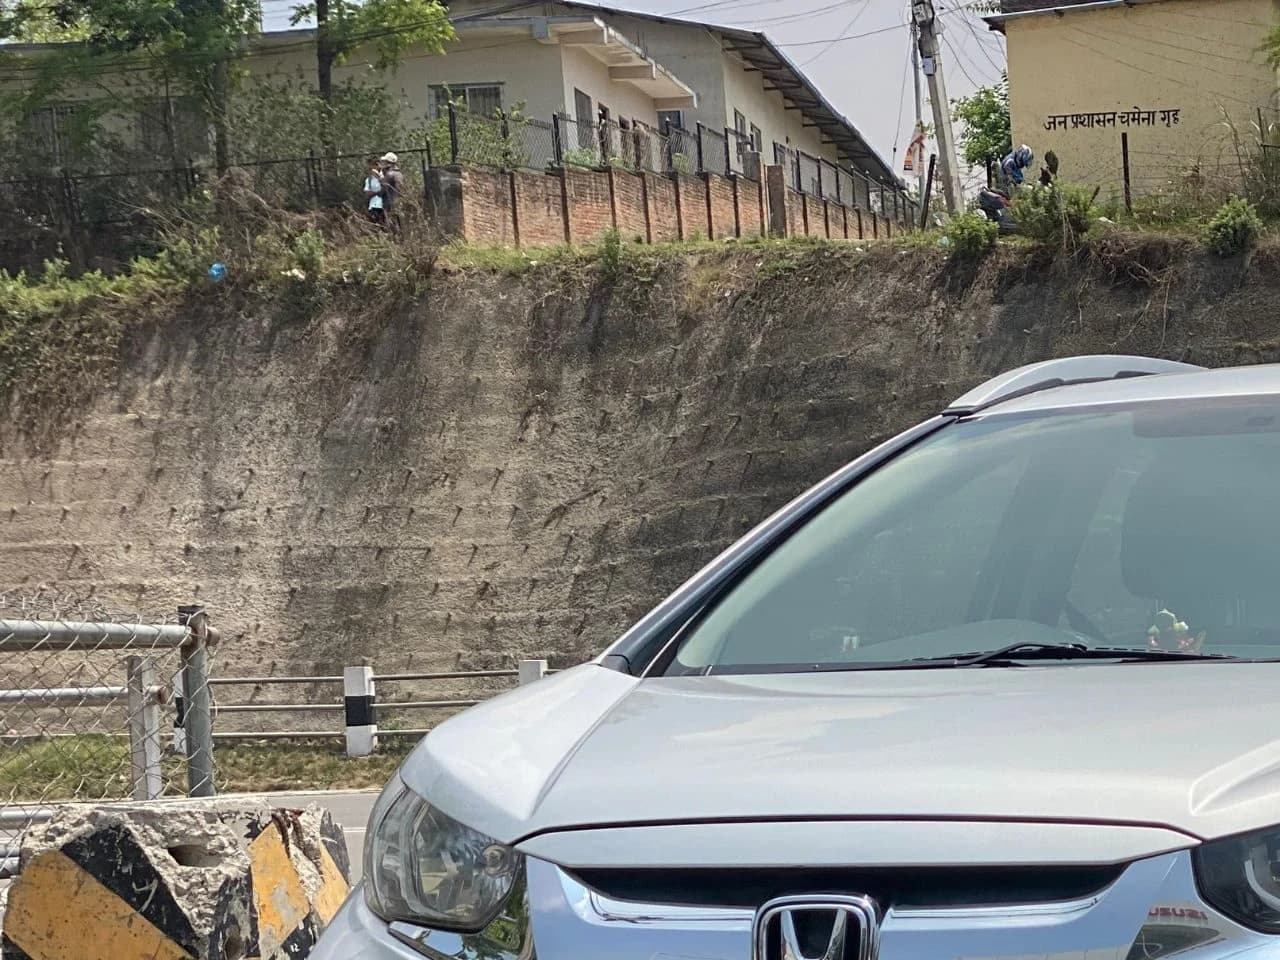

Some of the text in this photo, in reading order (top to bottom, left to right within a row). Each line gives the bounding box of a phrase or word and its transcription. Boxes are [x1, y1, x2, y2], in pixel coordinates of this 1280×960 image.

[1043, 106, 1181, 131] जन प्रशासन चमेना गृह
